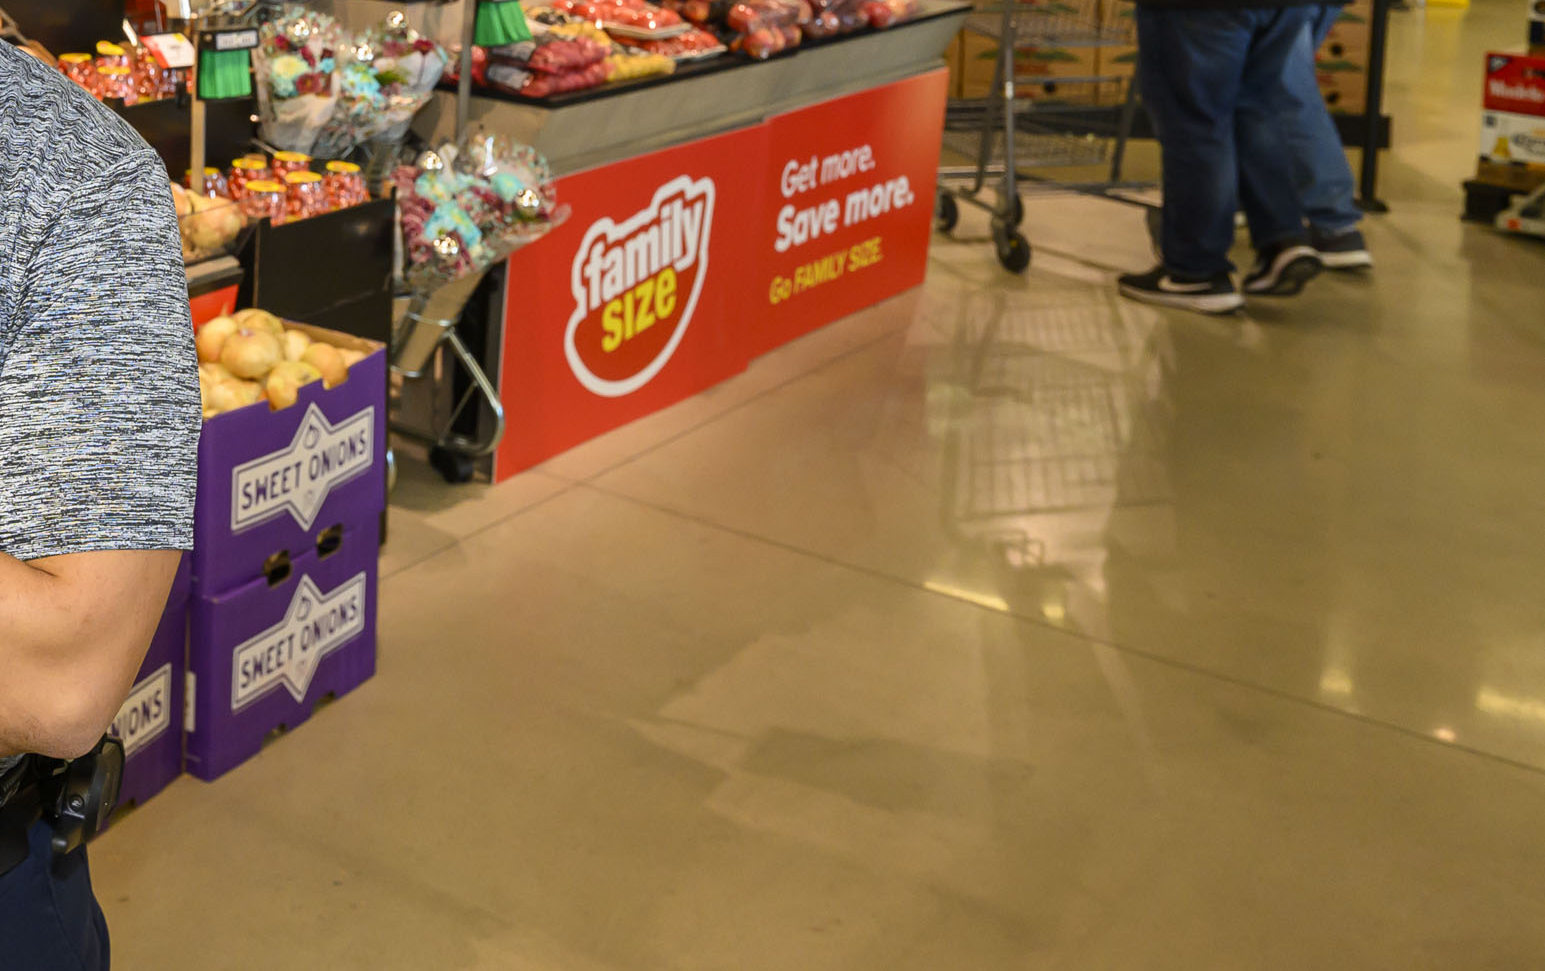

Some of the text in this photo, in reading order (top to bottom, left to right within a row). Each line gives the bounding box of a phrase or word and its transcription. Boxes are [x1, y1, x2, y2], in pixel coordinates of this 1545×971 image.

[780, 144, 876, 199] Get more.
[584, 198, 704, 311] family
[774, 175, 915, 253] Save more.
[601, 266, 677, 353] size
[769, 276, 792, 305] Go
[793, 250, 849, 294] FAMILY
[241, 429, 367, 510] SWEET ONIONS
[240, 595, 357, 689] SWEET ONIONS
